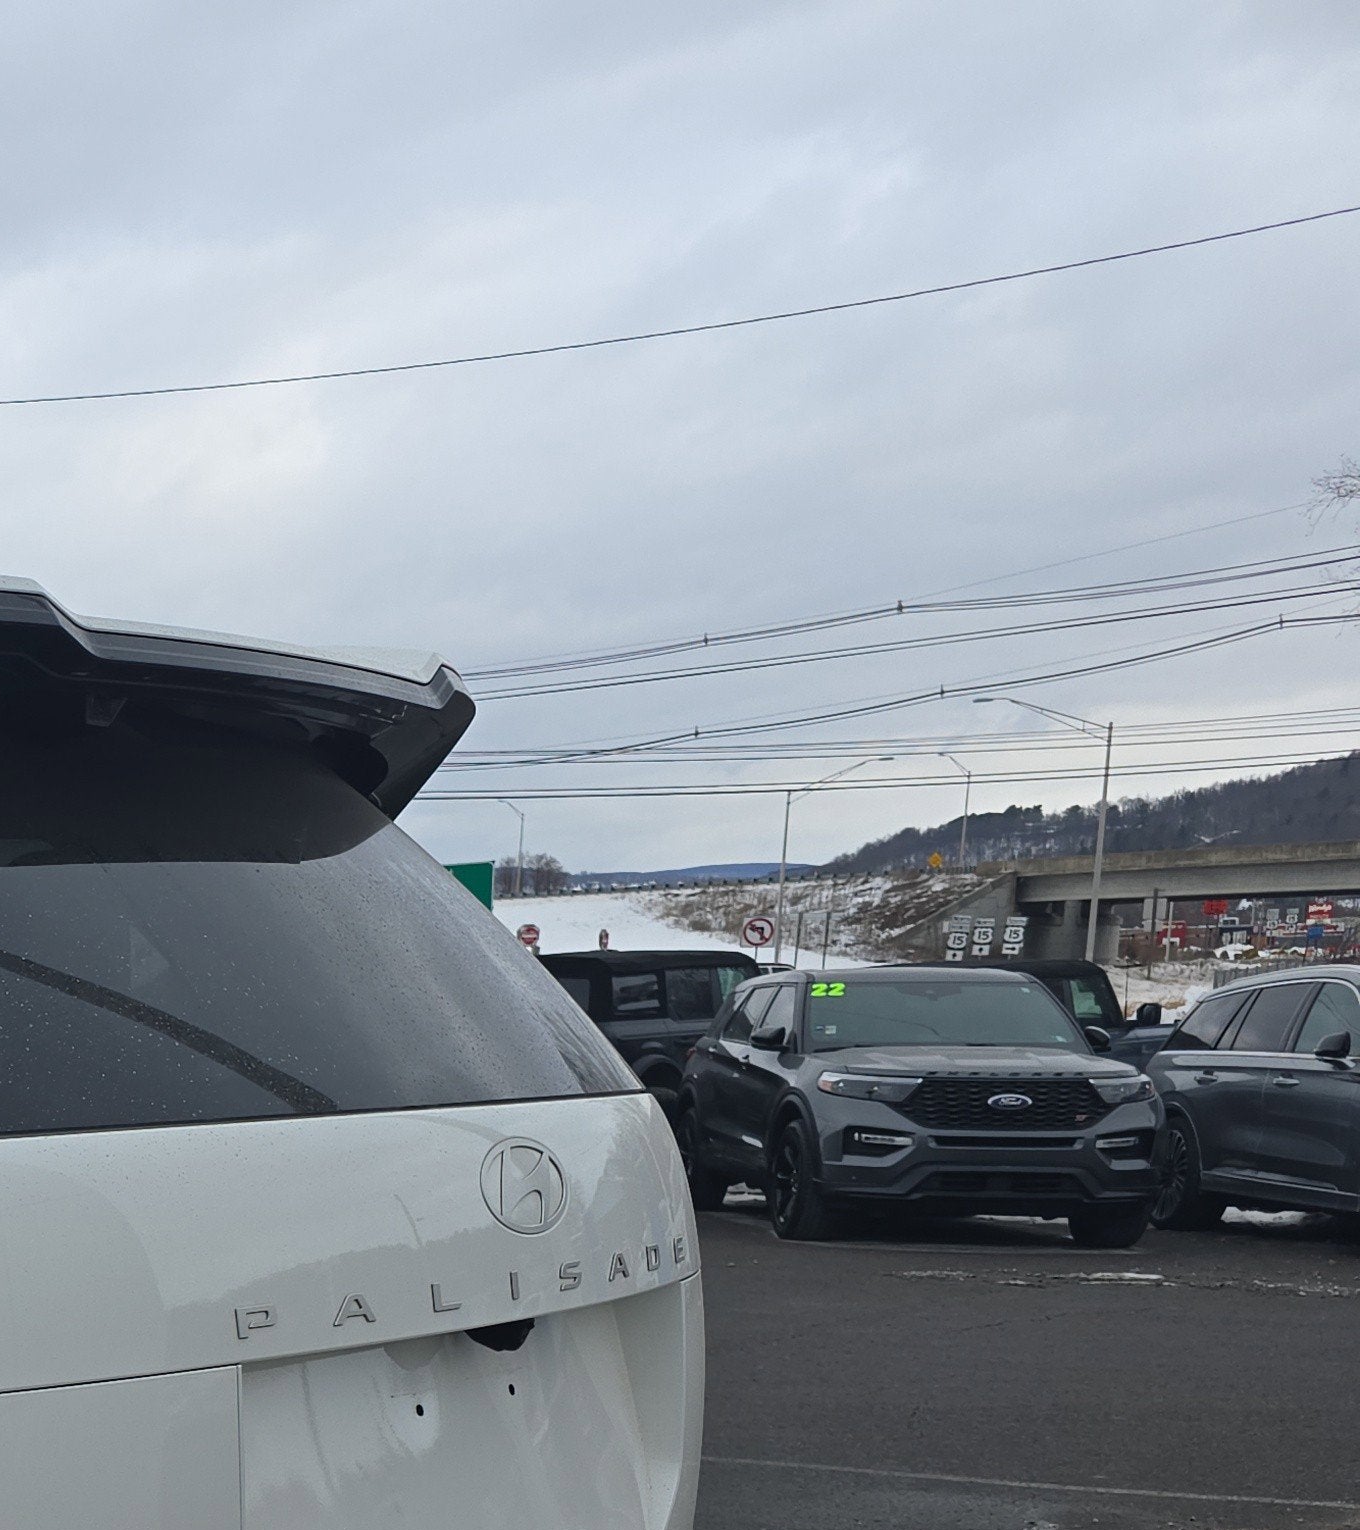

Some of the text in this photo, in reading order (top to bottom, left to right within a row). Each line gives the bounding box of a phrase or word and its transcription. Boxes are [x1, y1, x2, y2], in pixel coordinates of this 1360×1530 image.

[978, 930, 989, 941] 15
[1008, 929, 1020, 940] 15
[952, 935, 964, 946] 15
[810, 982, 846, 997] 22
[233, 1236, 687, 1340] PALISADE
